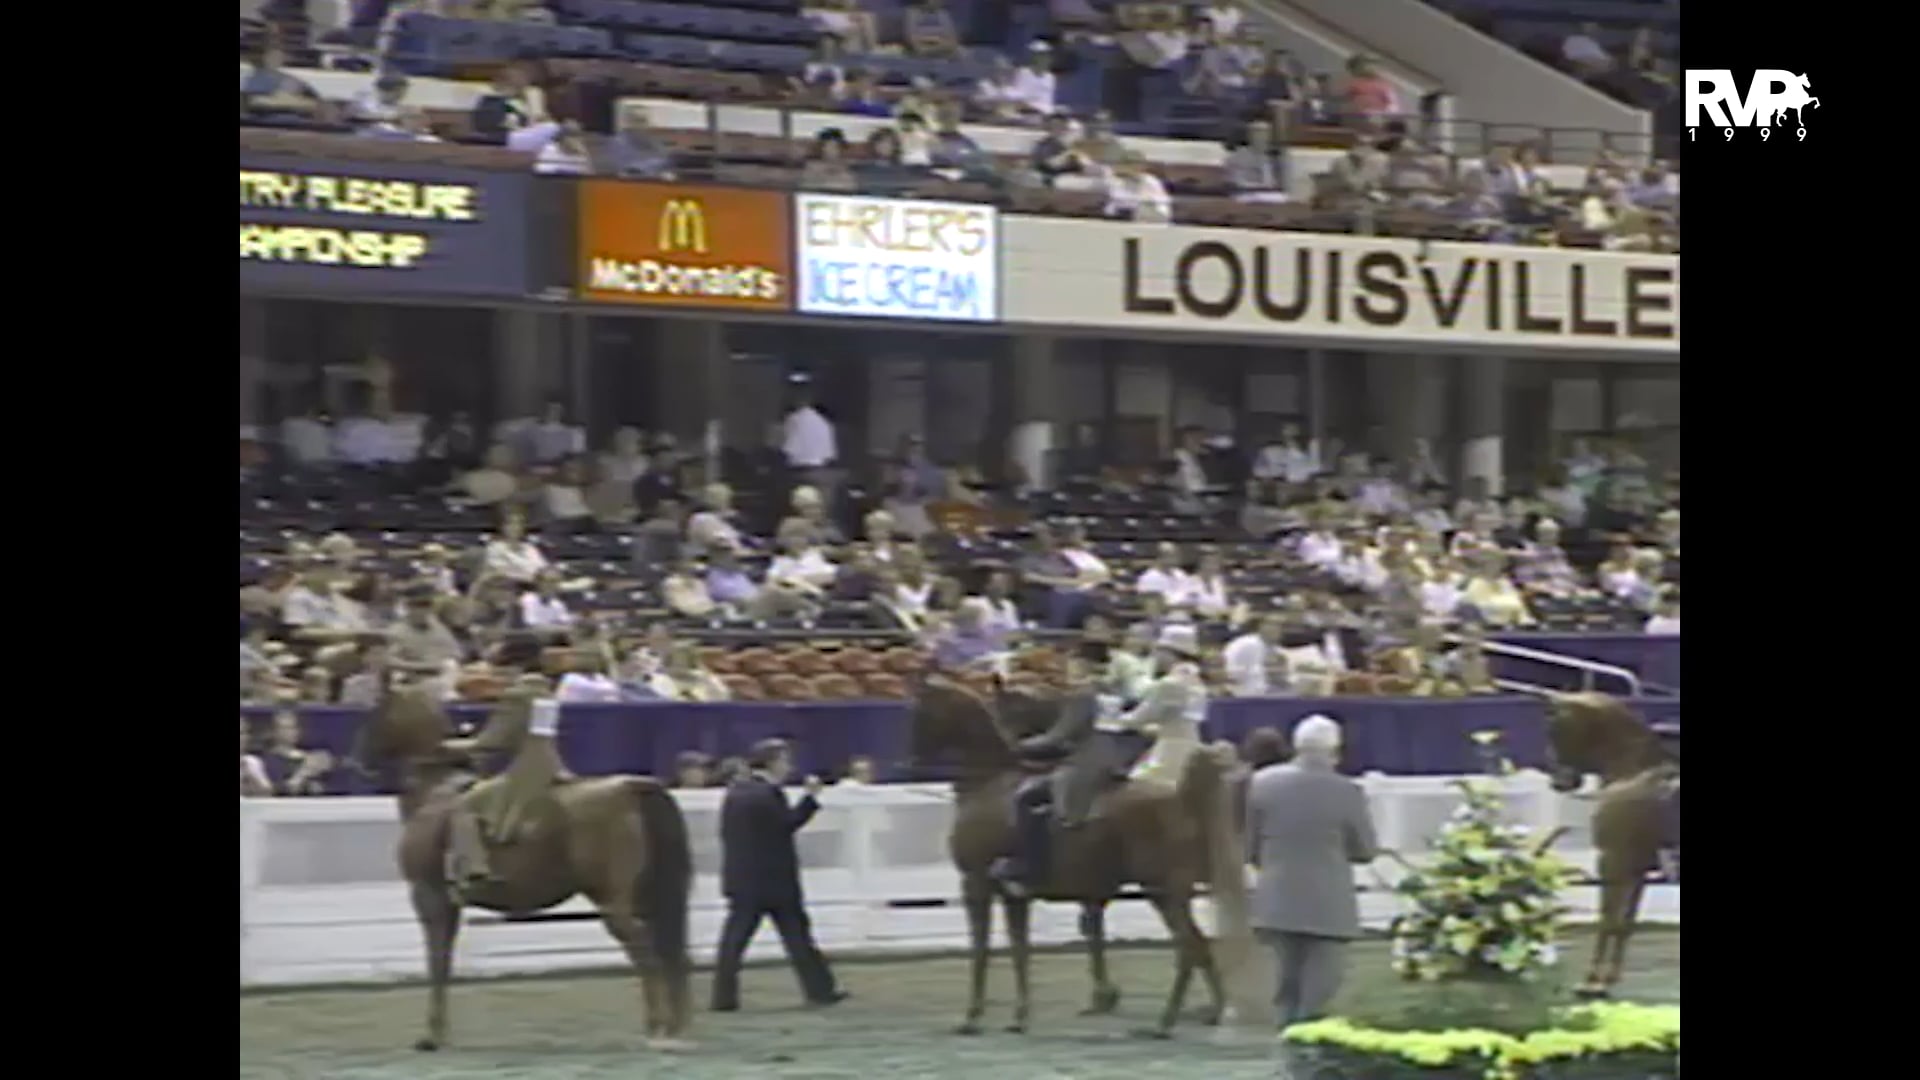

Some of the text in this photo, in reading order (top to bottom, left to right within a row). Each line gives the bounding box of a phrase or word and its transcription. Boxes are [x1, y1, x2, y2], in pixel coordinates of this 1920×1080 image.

[305, 176, 478, 220] PLEASURE
[806, 202, 987, 256] EHRLER'S
[590, 258, 779, 300] McDonald's
[808, 259, 980, 318] ICE CREAM
[1123, 238, 1675, 338] LOUISVILLE
